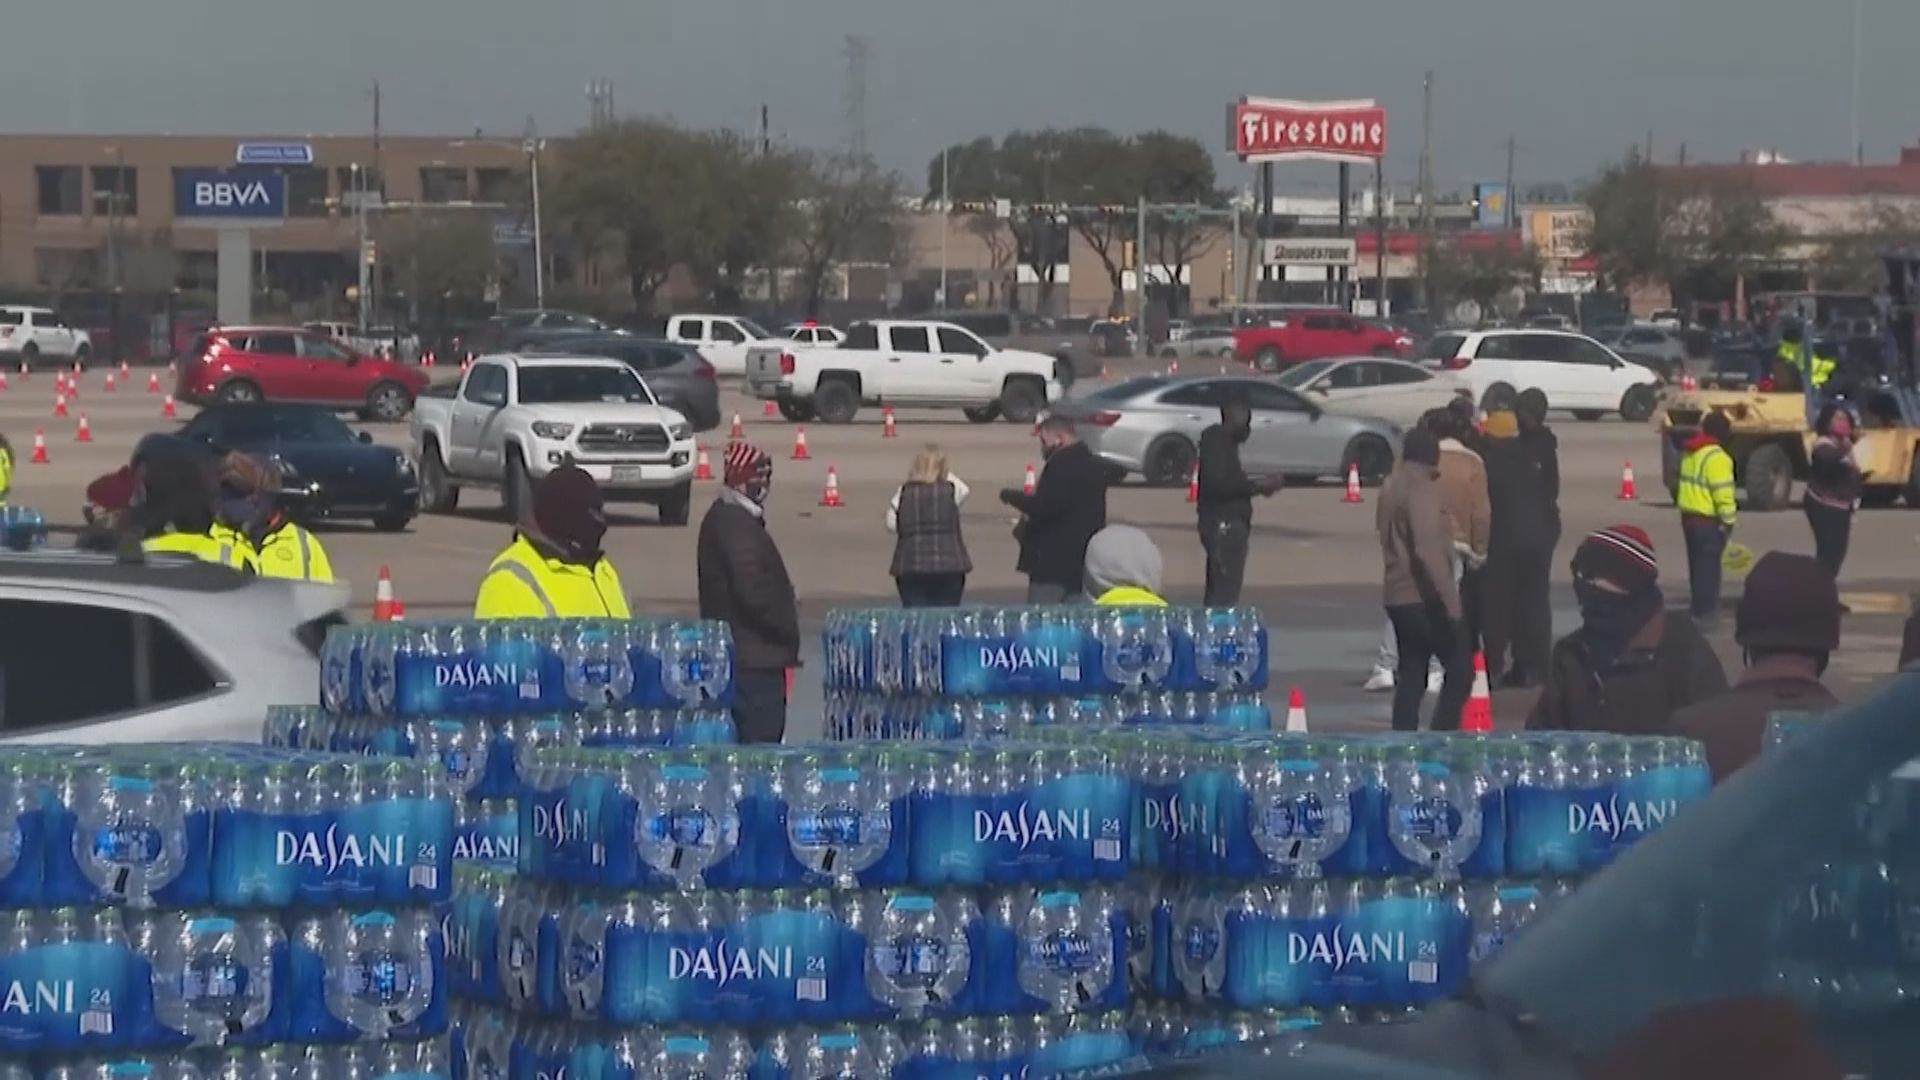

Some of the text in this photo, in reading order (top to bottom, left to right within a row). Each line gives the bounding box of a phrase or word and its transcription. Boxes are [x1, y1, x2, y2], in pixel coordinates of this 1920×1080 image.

[1242, 112, 1382, 146] Firestone
[195, 181, 270, 206] BBVA
[435, 659, 517, 689] DASANI
[979, 642, 1058, 673] DASANI
[974, 801, 1120, 850] DASANI 24
[276, 822, 437, 876] DASANI 24
[668, 938, 826, 988] DASANI 24
[1288, 923, 1437, 972] DASANI 24
[90, 988, 110, 1005] 24
